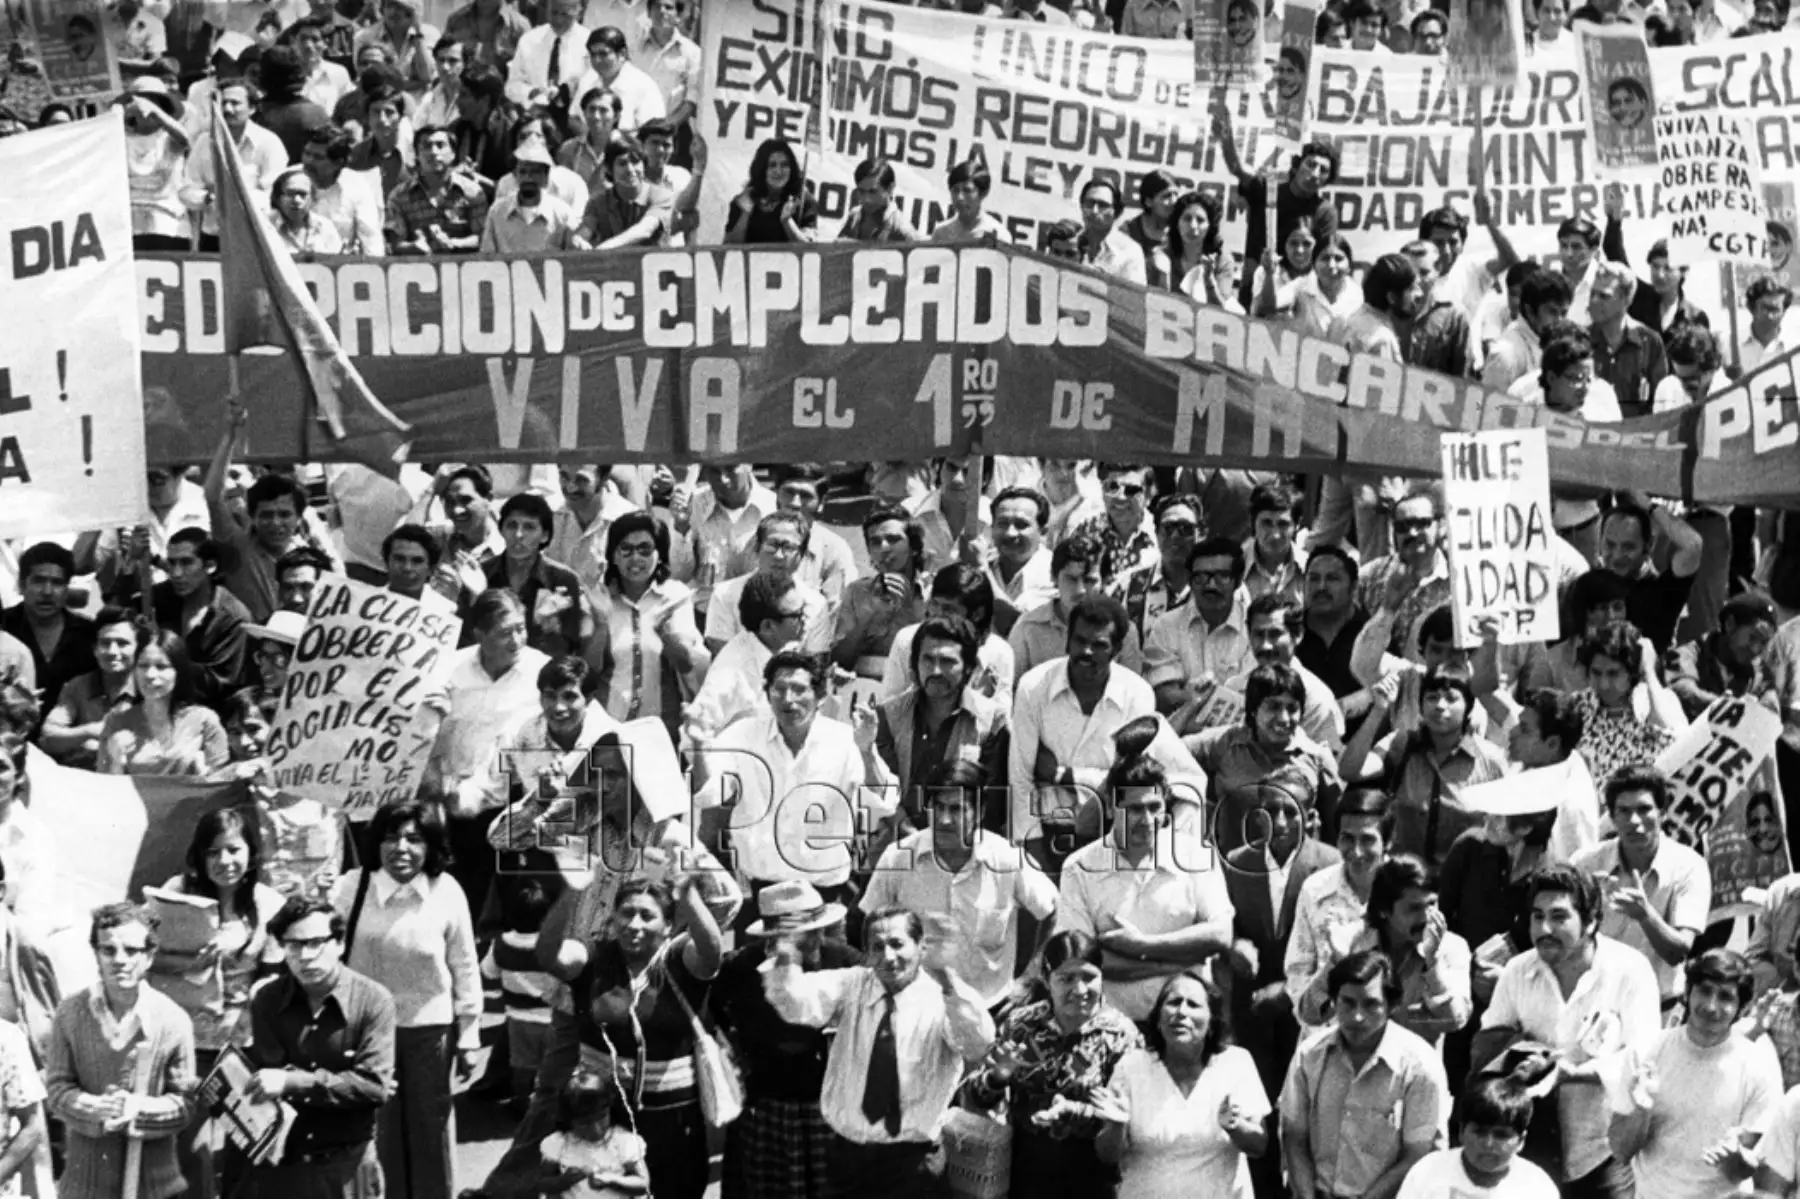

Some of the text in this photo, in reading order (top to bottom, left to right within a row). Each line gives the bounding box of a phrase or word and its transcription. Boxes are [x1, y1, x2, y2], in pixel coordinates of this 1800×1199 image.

[972, 24, 1147, 101] UNICO
[745, 102, 937, 169] PEIMOS
[1001, 151, 1084, 199] LEY
[1660, 137, 1749, 163] ALIANZA
[1718, 115, 1741, 137] LA
[10, 212, 106, 280] DIA
[1671, 214, 1708, 239] NA!
[568, 280, 636, 332] DE
[642, 246, 1109, 348] EMPLEADOS
[486, 356, 742, 453] VIVA
[793, 377, 855, 428] EL
[1050, 380, 1115, 430] DE
[311, 583, 454, 645] LA CLASE
[296, 623, 440, 676] OBRERA
[285, 663, 422, 712] POR EL
[316, 762, 343, 785] EL
[343, 736, 399, 763] MO
